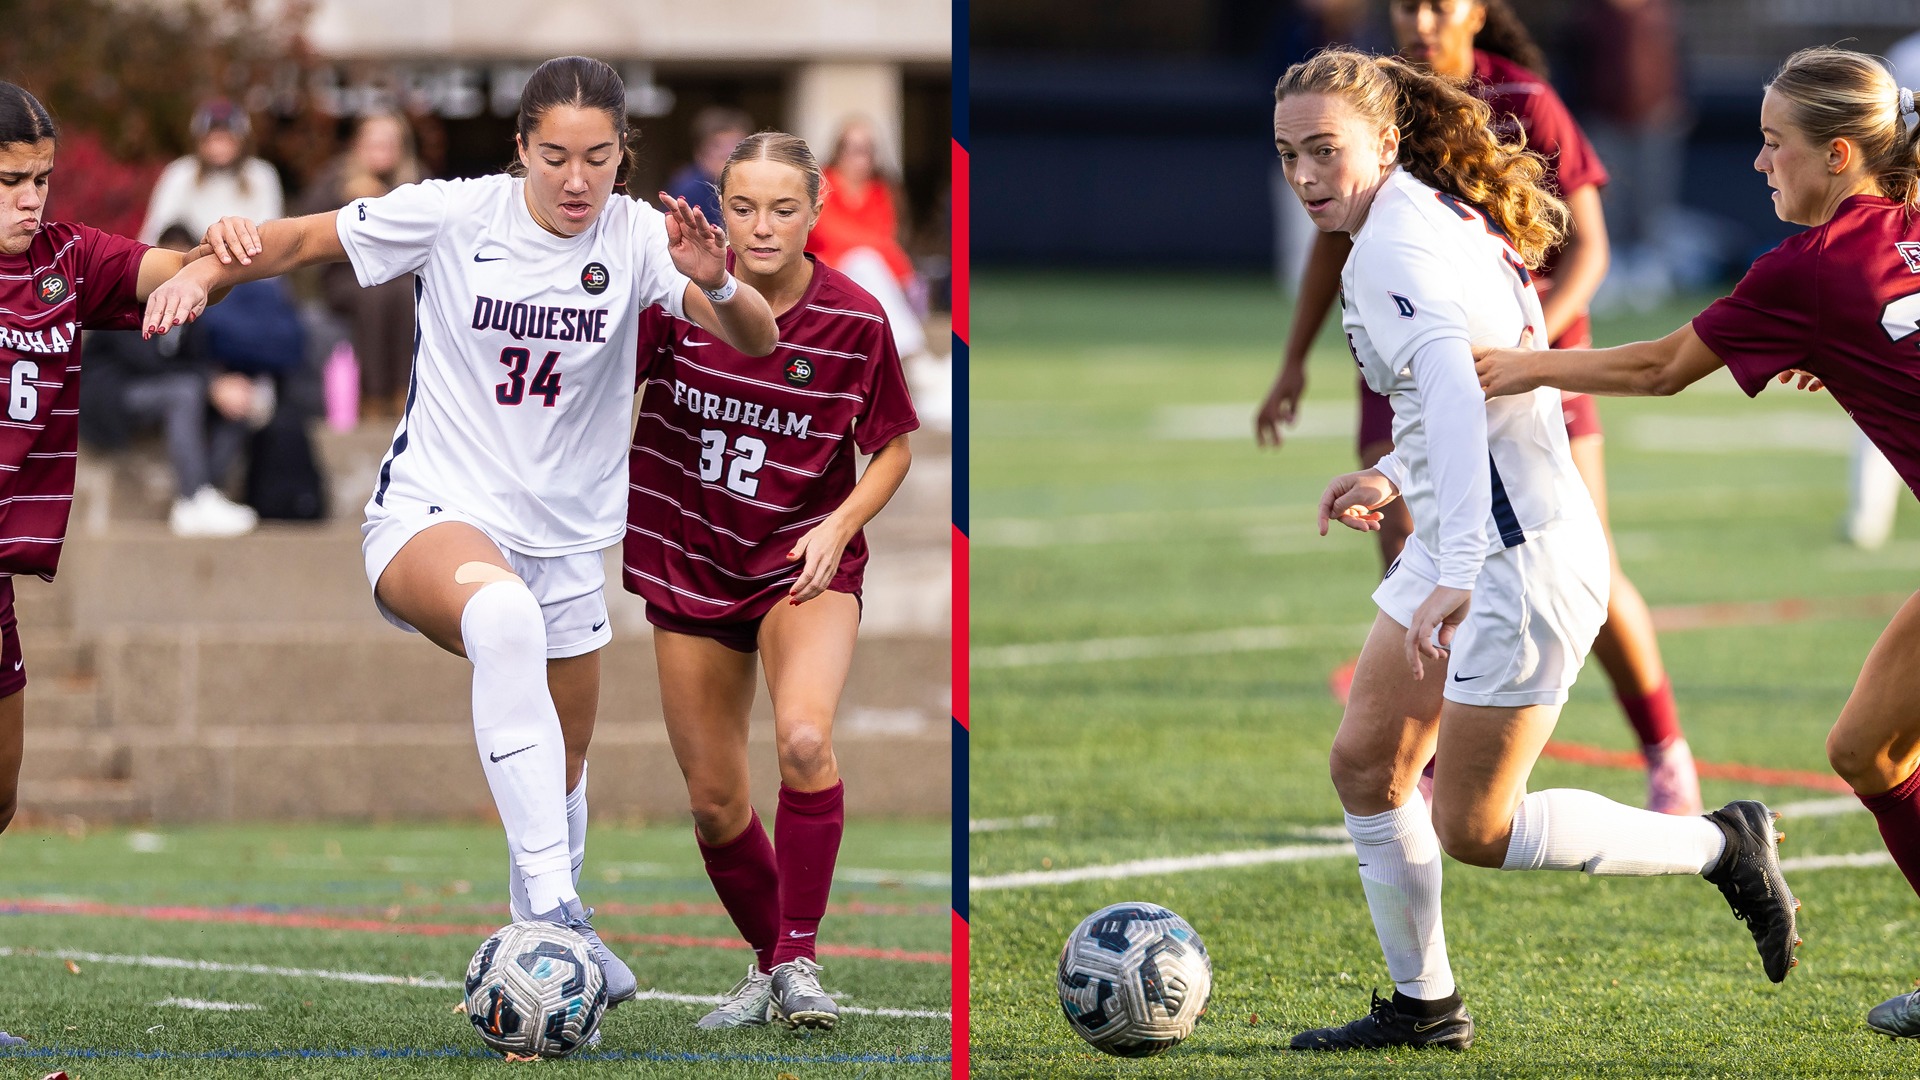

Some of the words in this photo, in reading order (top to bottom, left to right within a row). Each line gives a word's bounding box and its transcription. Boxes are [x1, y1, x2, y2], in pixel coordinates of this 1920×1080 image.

[472, 295, 609, 343] DUQUESNE
[7, 359, 39, 422] 6
[495, 346, 562, 407] 34
[673, 379, 812, 440] FORDHAM
[699, 428, 767, 498] 32
